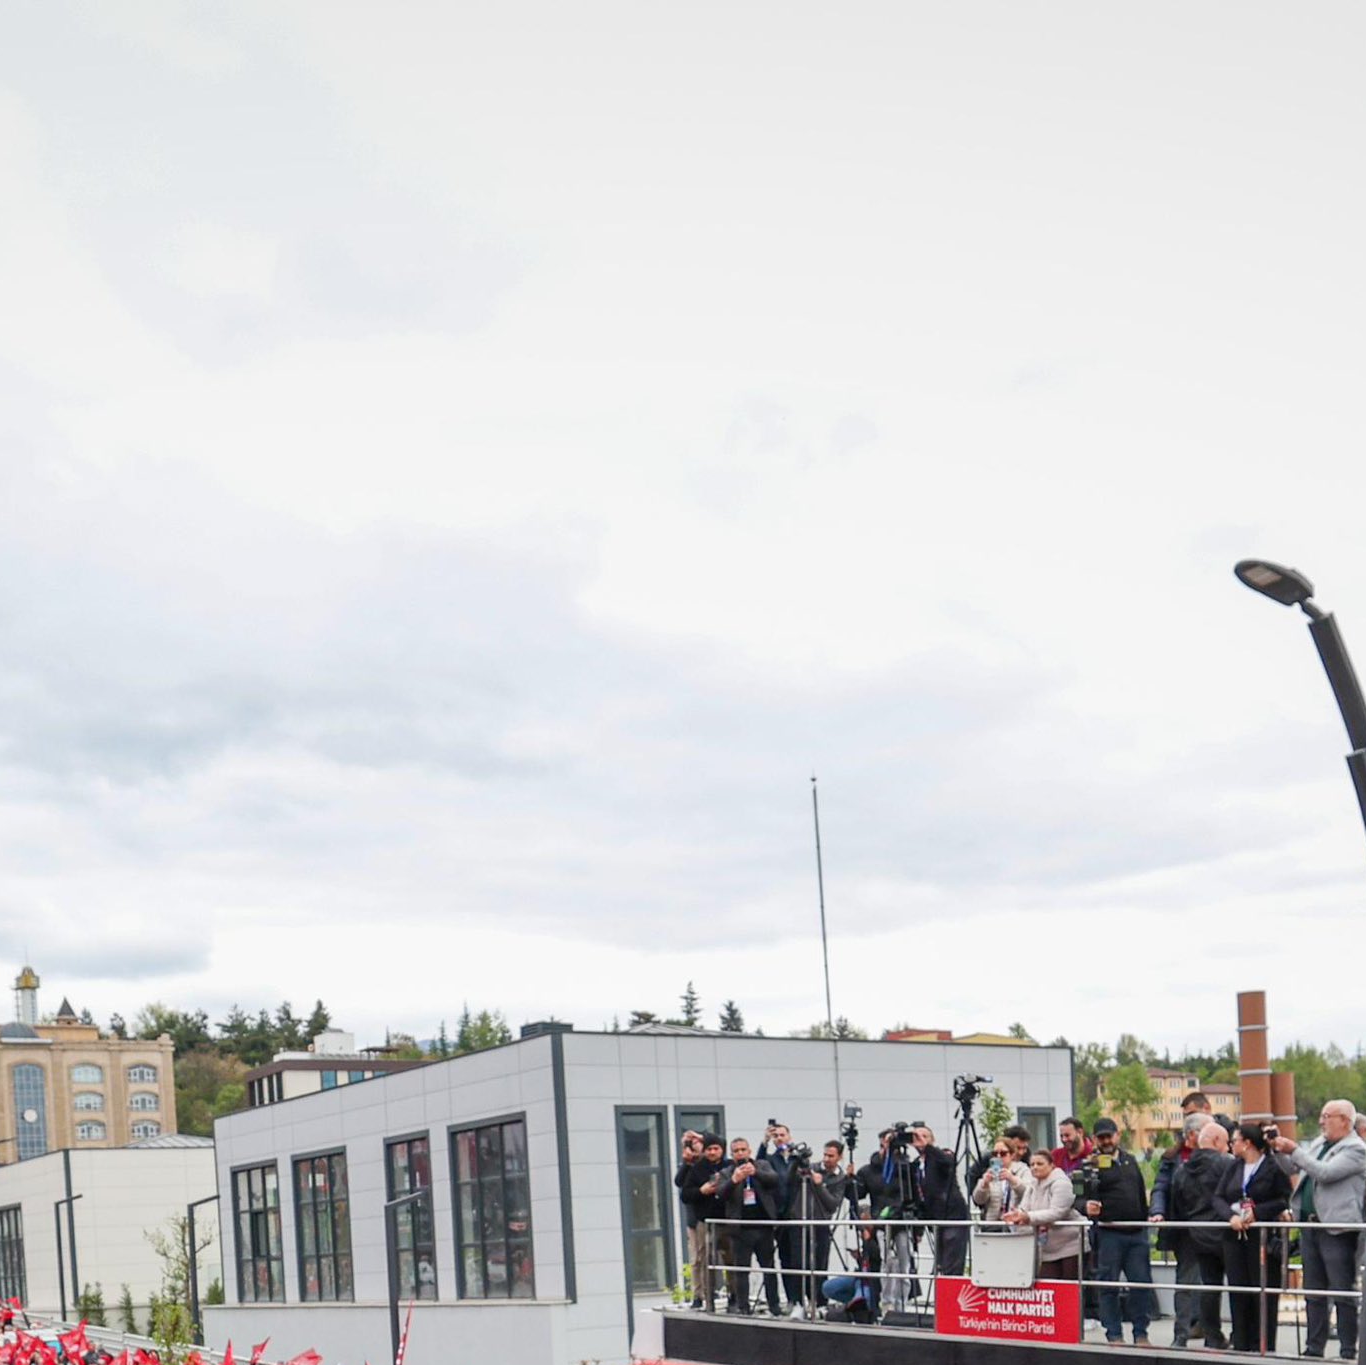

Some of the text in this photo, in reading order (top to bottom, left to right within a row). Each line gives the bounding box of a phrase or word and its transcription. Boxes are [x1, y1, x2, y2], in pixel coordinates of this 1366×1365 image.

[987, 1301, 1055, 1317] HALK PARTİSİ
[1001, 1319, 1027, 1332] Birinci
[1028, 1321, 1055, 1334] Partisi
